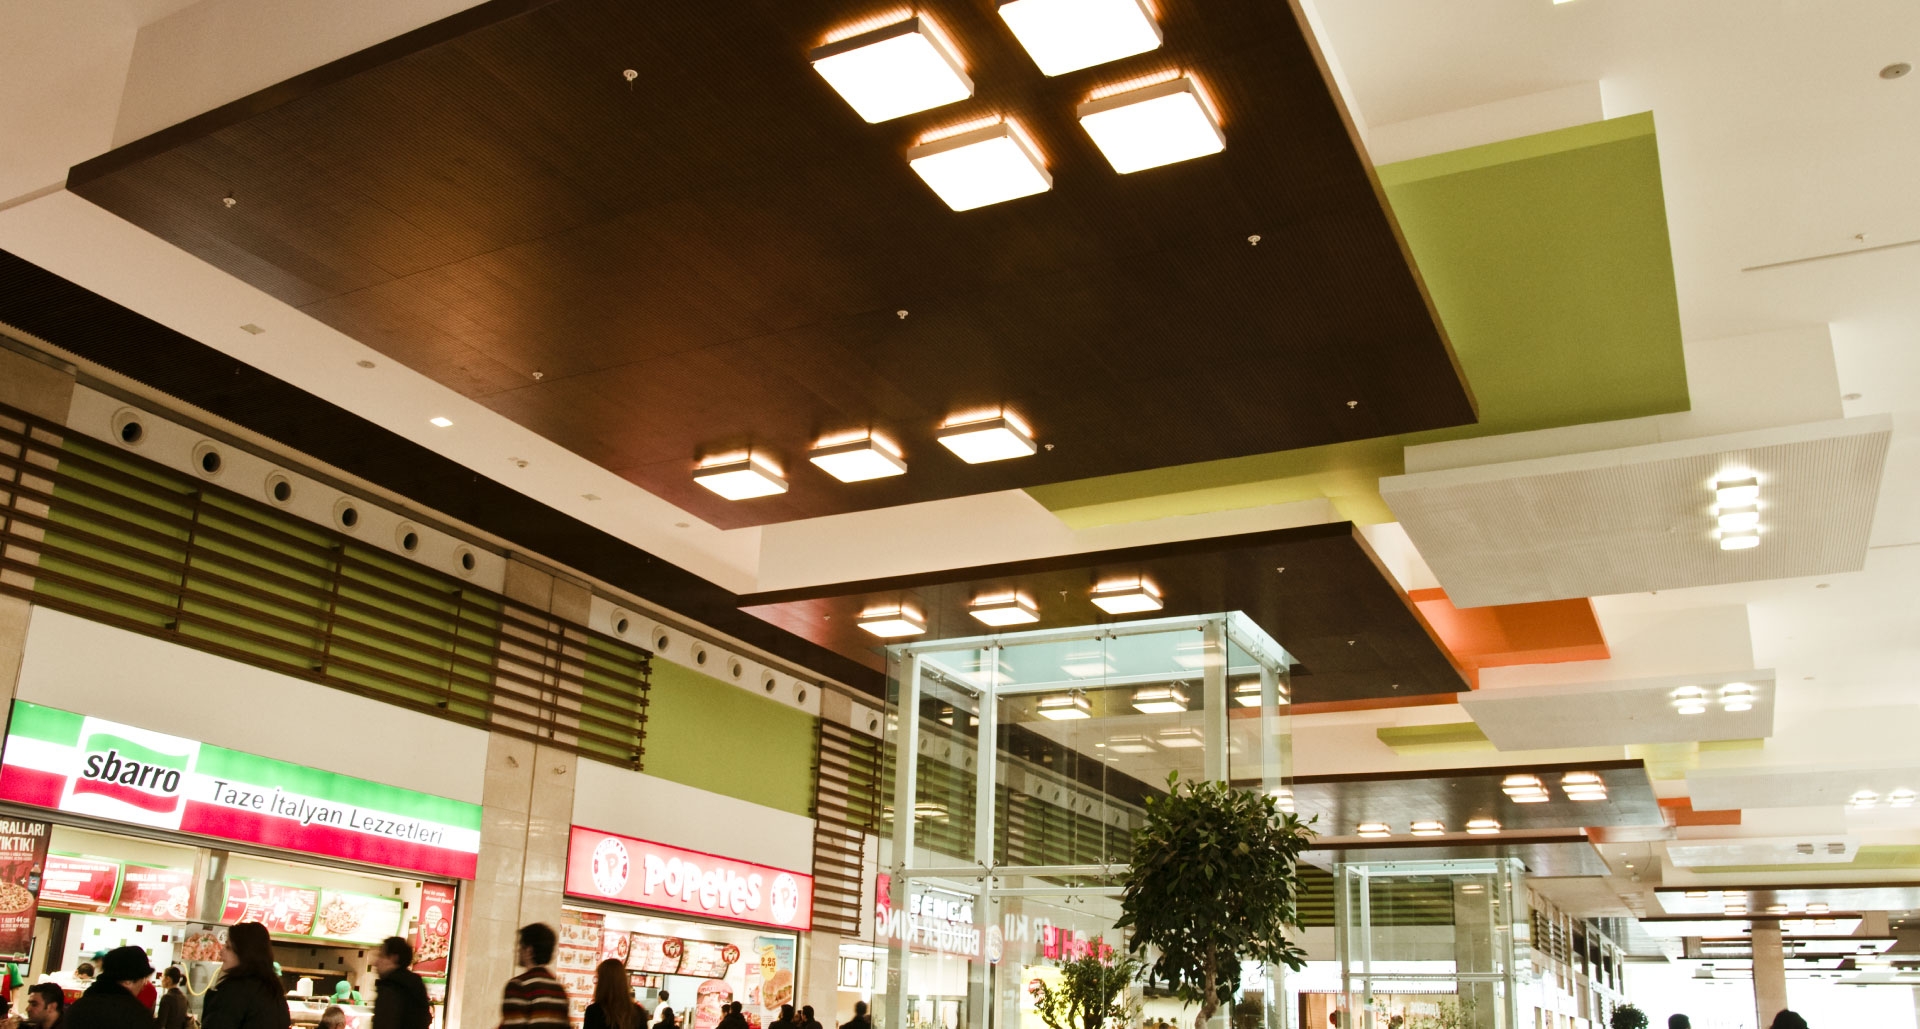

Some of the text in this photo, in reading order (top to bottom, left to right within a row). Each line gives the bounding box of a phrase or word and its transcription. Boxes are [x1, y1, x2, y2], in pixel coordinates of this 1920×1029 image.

[83, 751, 180, 792] sbarro
[213, 781, 444, 846] Taze İtalyan Lezzetleri
[0, 820, 45, 836] RALLARI
[0, 836, 35, 852] IKTIK!
[760, 957, 776, 968] 2,25
